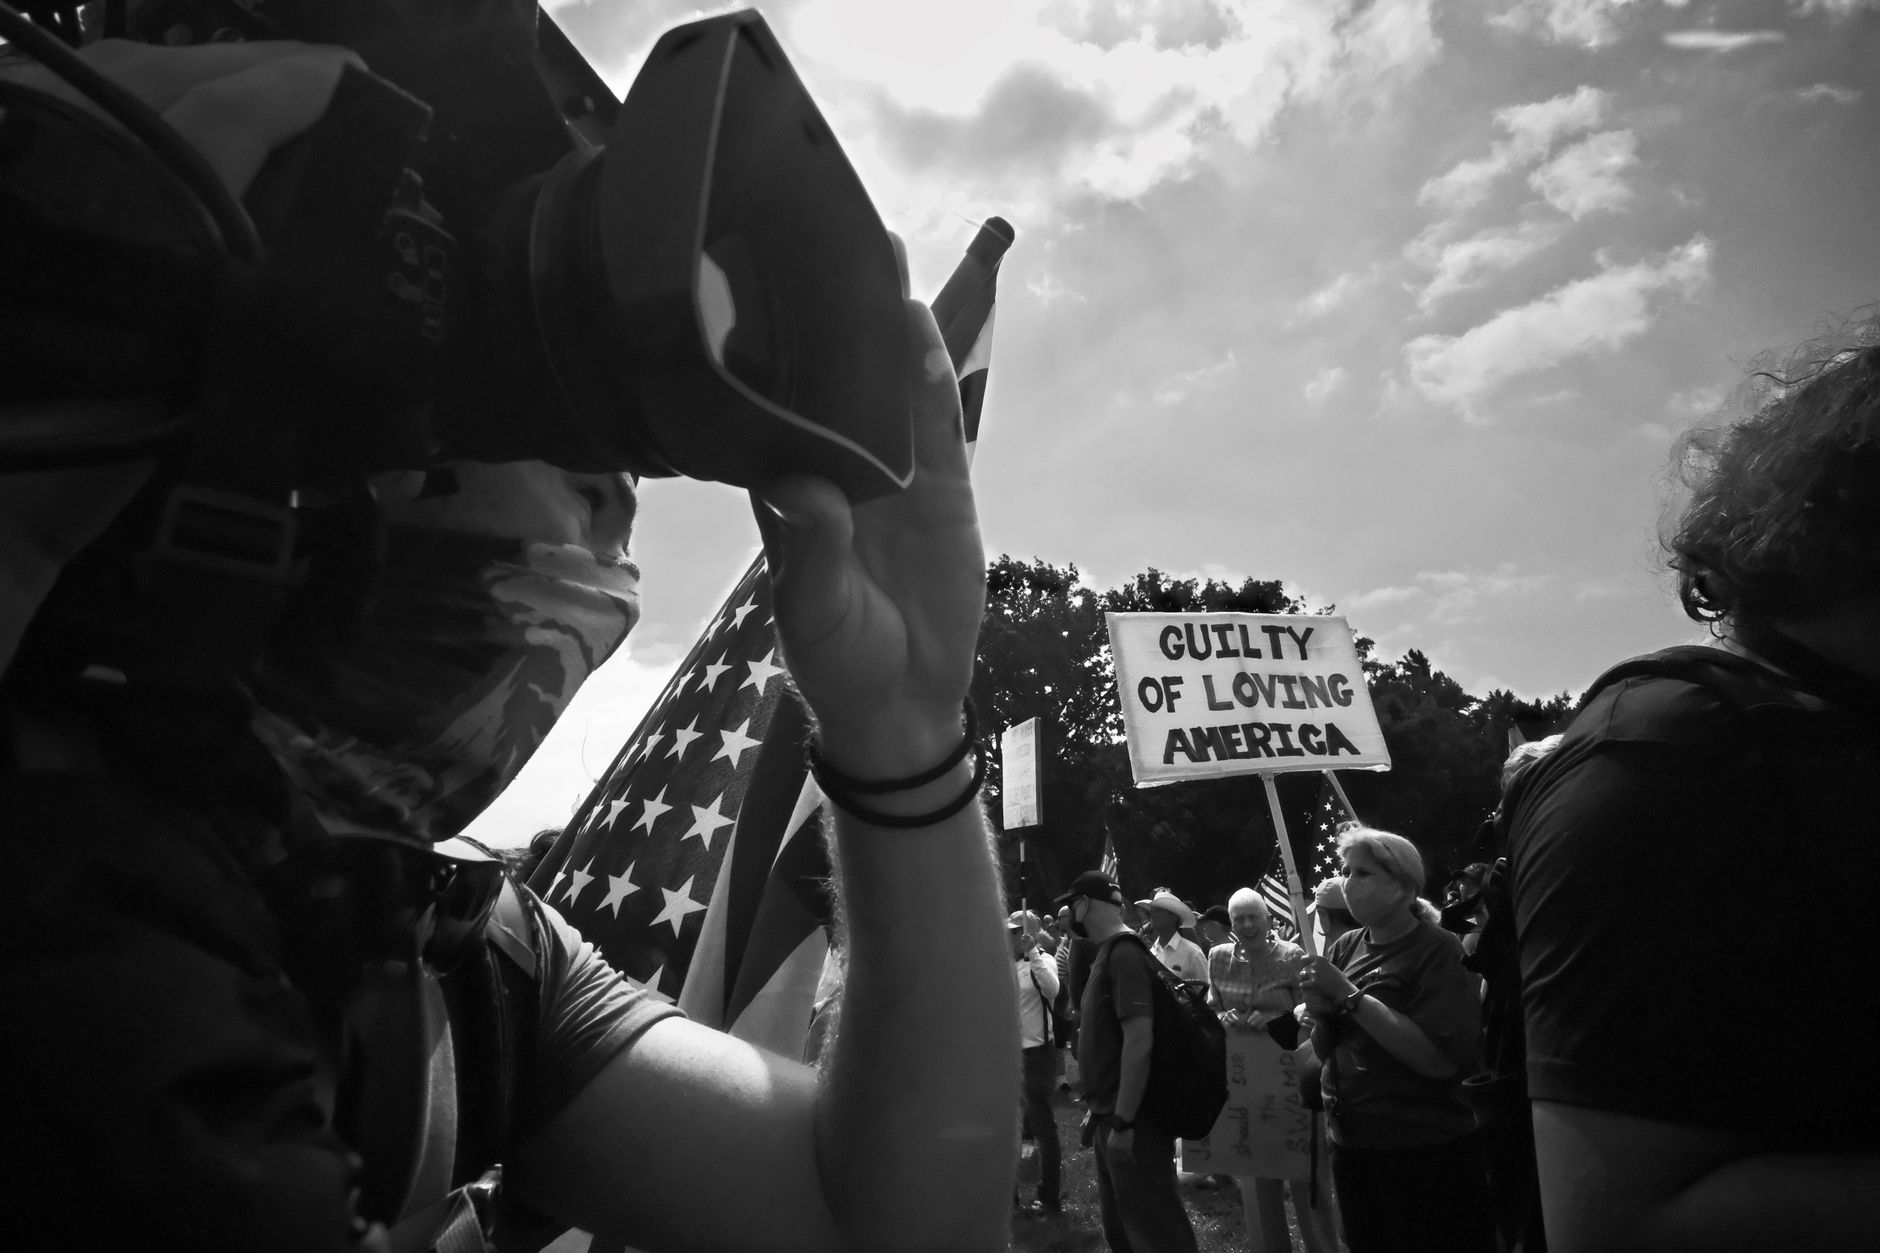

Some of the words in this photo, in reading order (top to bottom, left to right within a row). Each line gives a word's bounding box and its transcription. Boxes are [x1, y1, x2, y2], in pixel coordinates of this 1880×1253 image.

[1159, 623, 1313, 661] GUILTY
[1137, 676, 1184, 713] OF
[1202, 671, 1354, 711] LOVING
[1163, 722, 1361, 764] AMERICA
